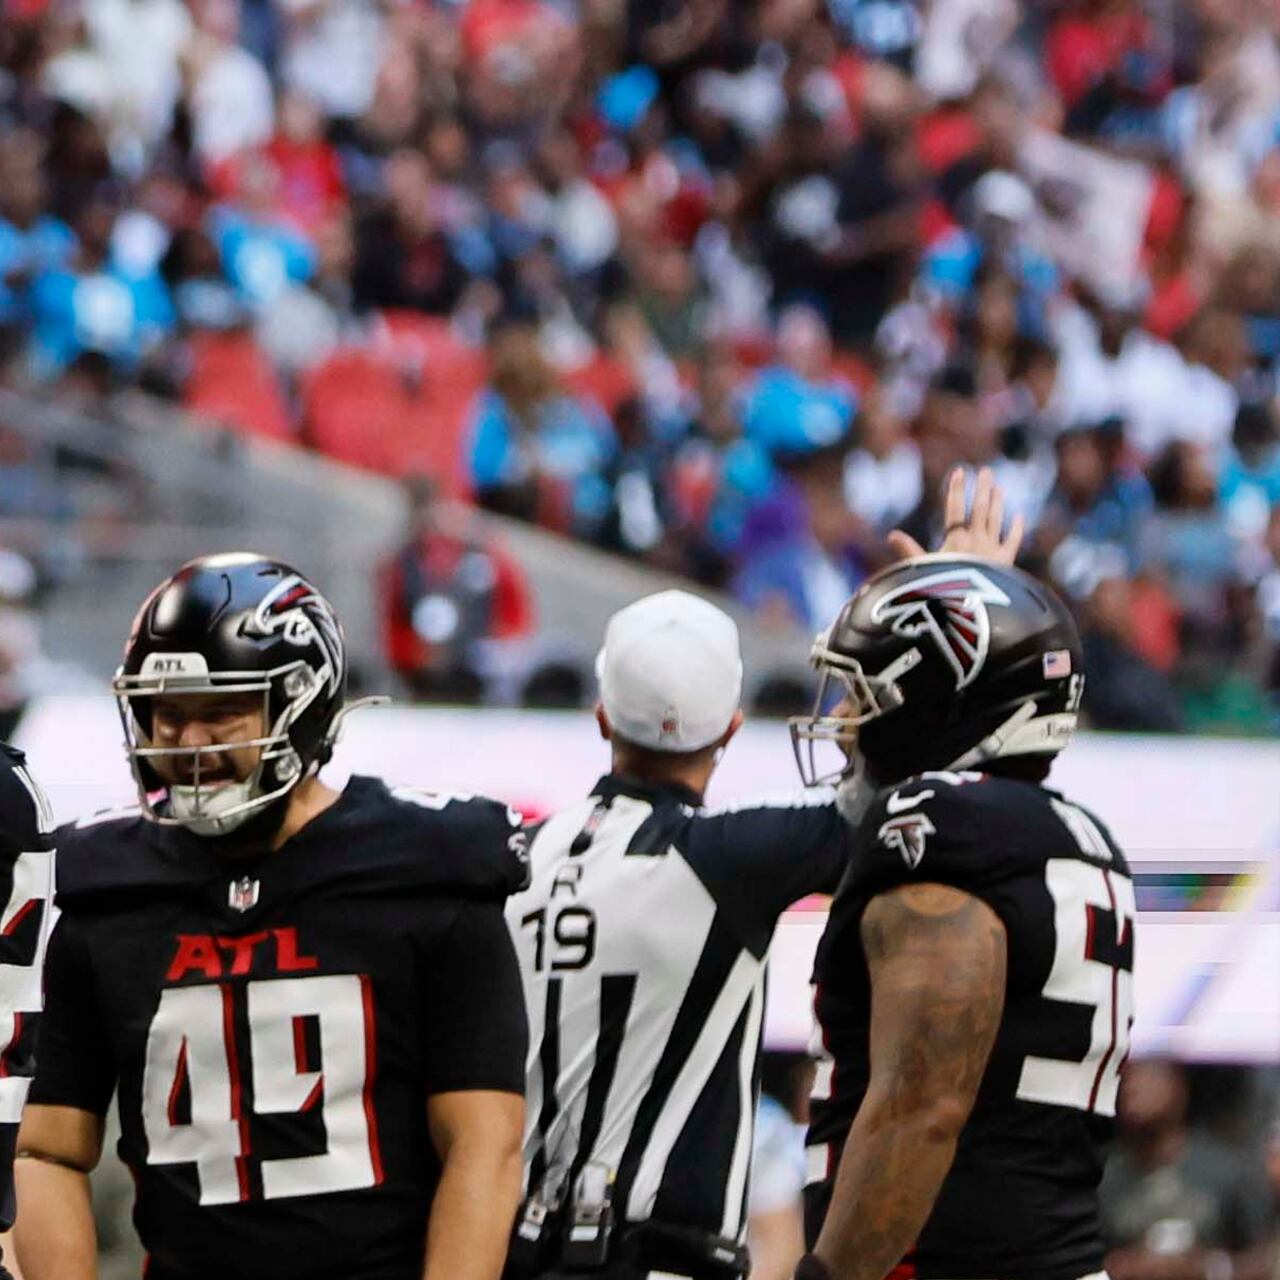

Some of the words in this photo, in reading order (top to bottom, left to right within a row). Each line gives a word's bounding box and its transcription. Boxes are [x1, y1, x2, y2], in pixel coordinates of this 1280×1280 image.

[153, 658, 187, 673] ATL
[164, 926, 320, 982] ATL
[521, 905, 597, 974] 19
[141, 973, 384, 1207] 49
